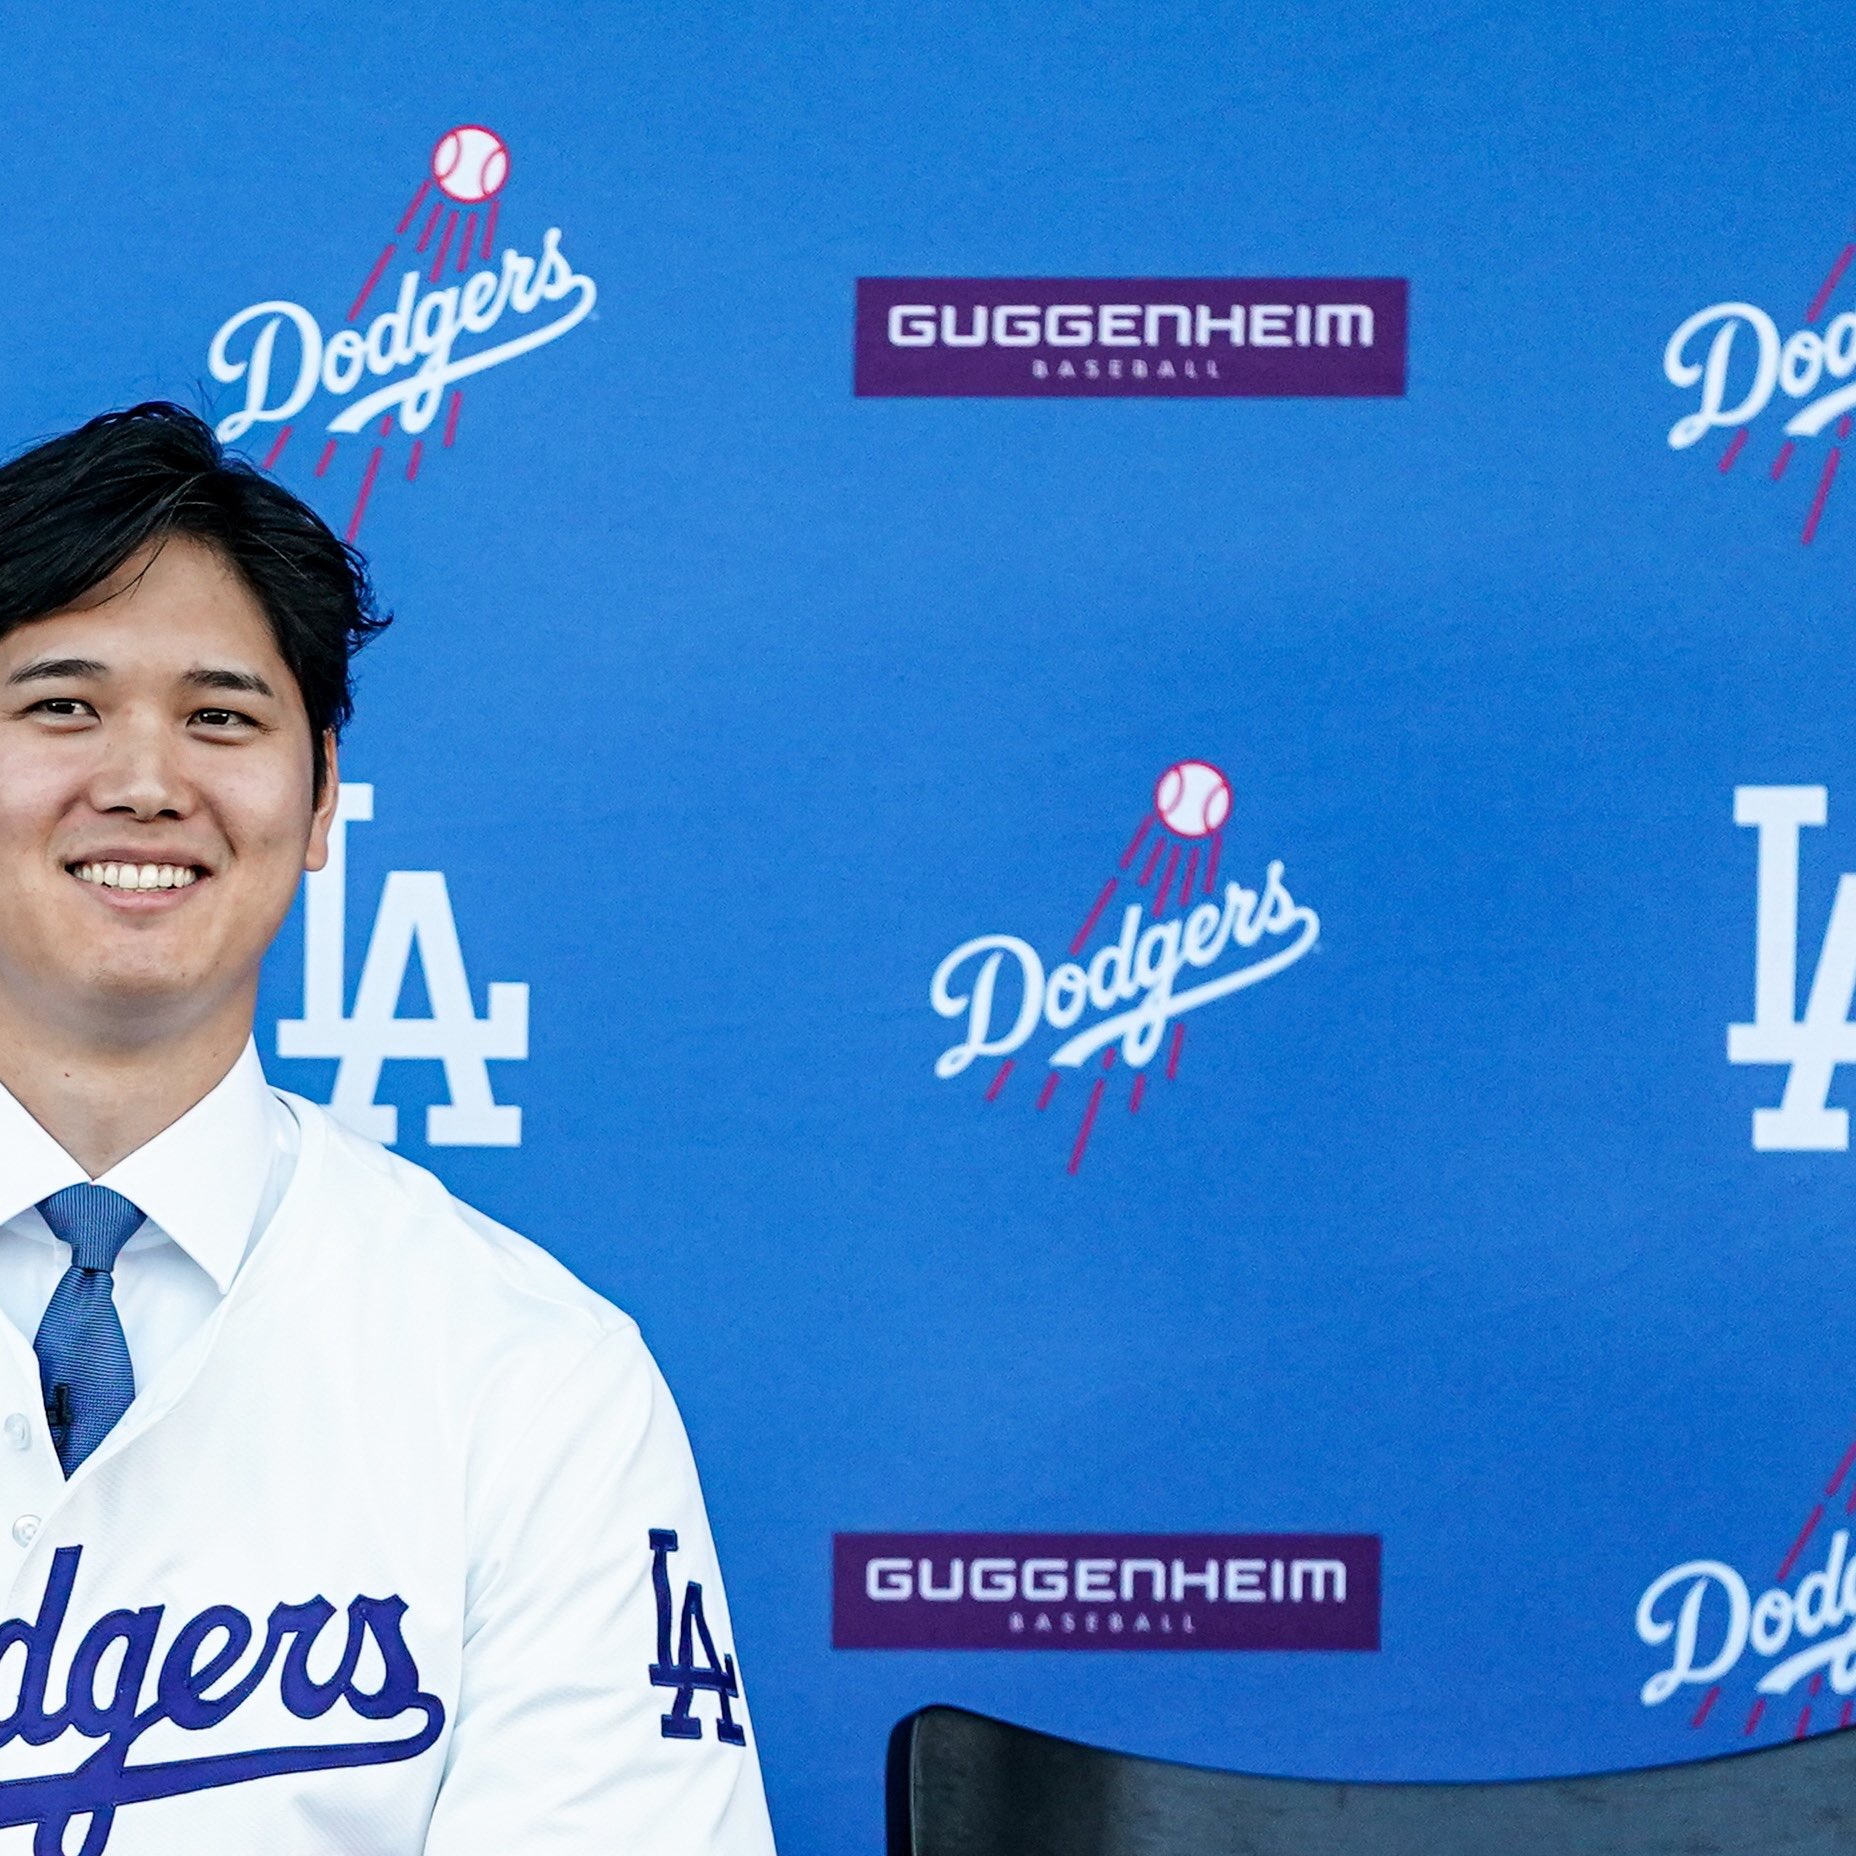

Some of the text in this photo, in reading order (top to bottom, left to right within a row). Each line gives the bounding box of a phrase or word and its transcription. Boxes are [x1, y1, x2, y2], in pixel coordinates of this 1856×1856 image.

[208, 227, 597, 444] Dodgers
[888, 304, 1375, 348] GUGGENHEIM
[1031, 358, 1219, 379] BASEBALL
[929, 860, 1320, 1079] Dodgers
[865, 1557, 1347, 1603] GUGGENHEIM
[648, 1528, 747, 1747] LA
[1009, 1612, 1196, 1633] BASEBALL
